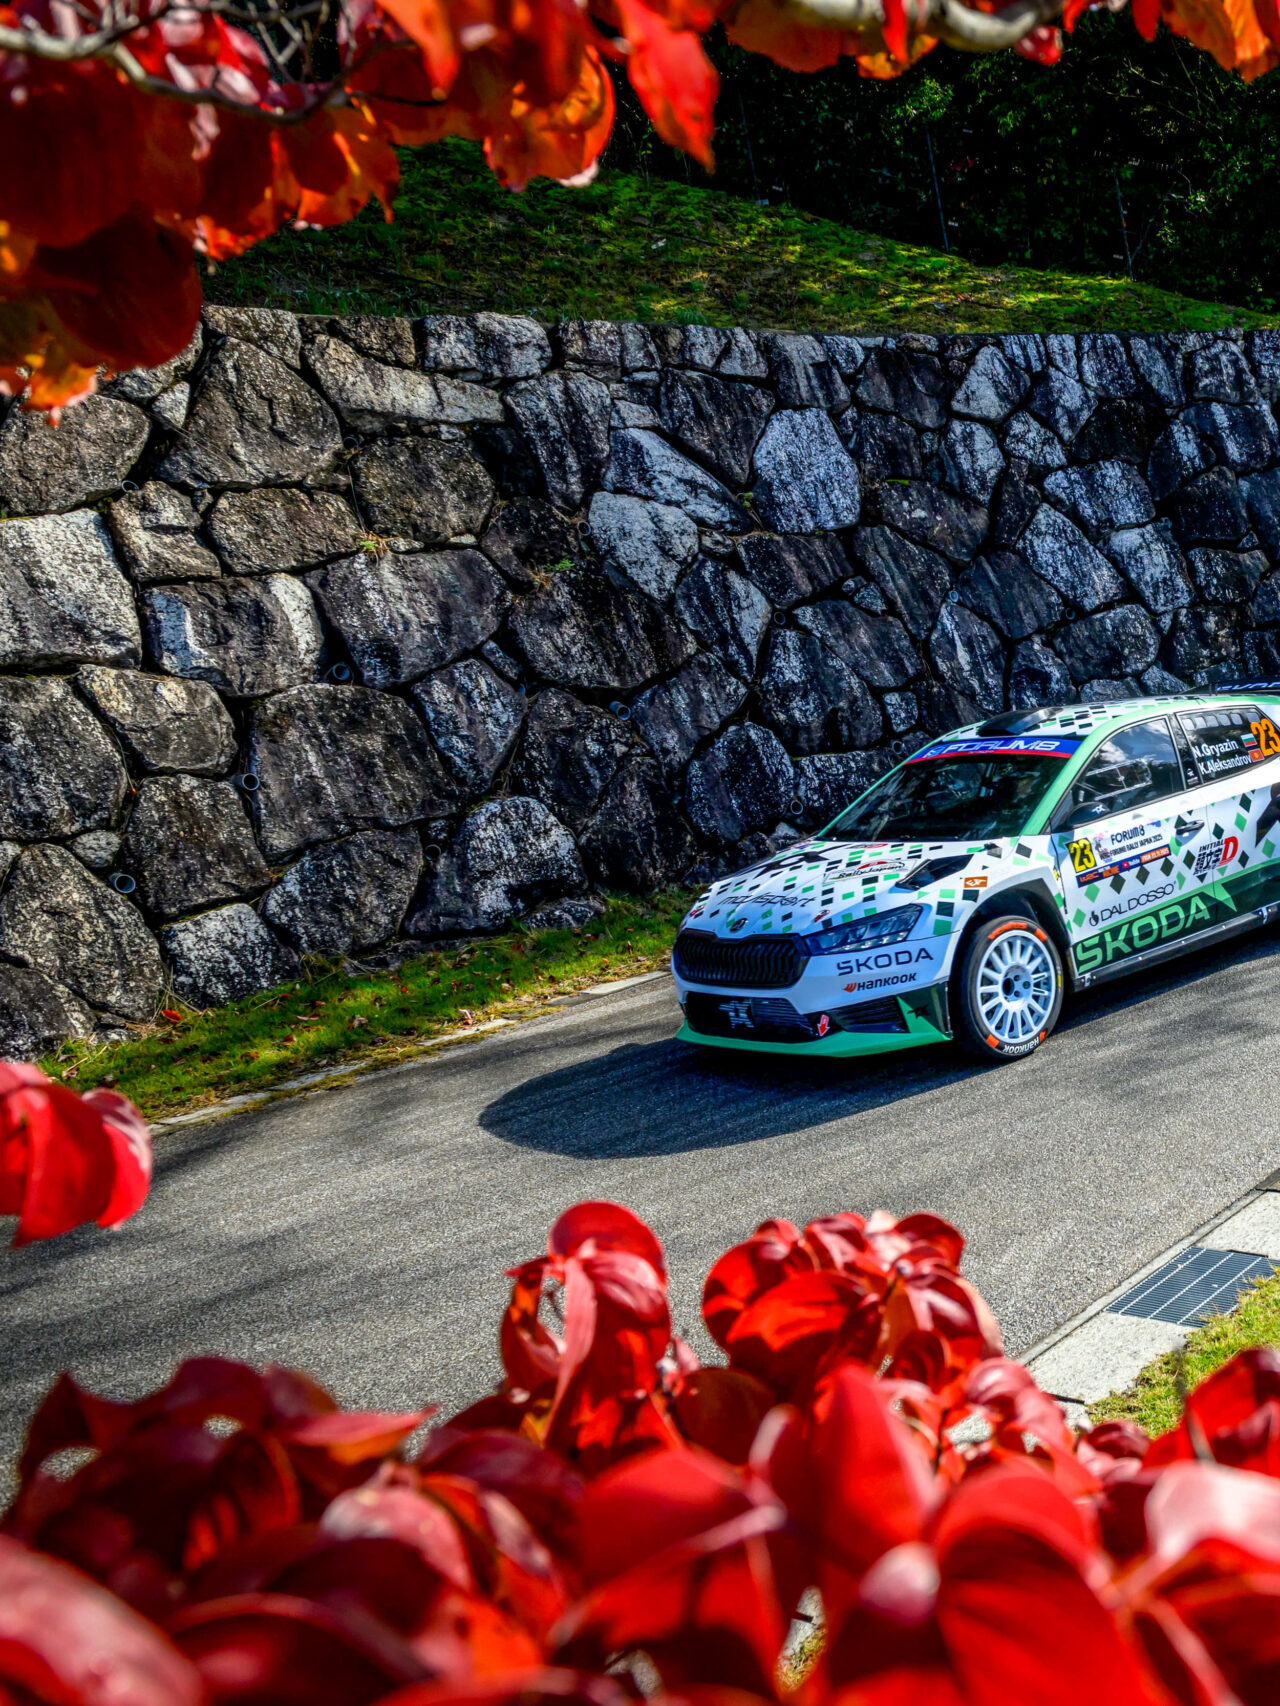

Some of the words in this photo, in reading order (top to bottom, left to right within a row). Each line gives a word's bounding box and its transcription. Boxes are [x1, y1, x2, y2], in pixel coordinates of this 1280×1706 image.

[943, 740, 1061, 753] FORUM8
[1192, 739, 1239, 759] N.Gryazin
[1198, 754, 1252, 775] K.Aleksandrov
[1111, 824, 1145, 845] FORUM8
[1069, 838, 1096, 873] 23
[1199, 839, 1224, 852] INITIAL
[1101, 903, 1127, 921] DAL
[1128, 883, 1174, 910] DOSSO
